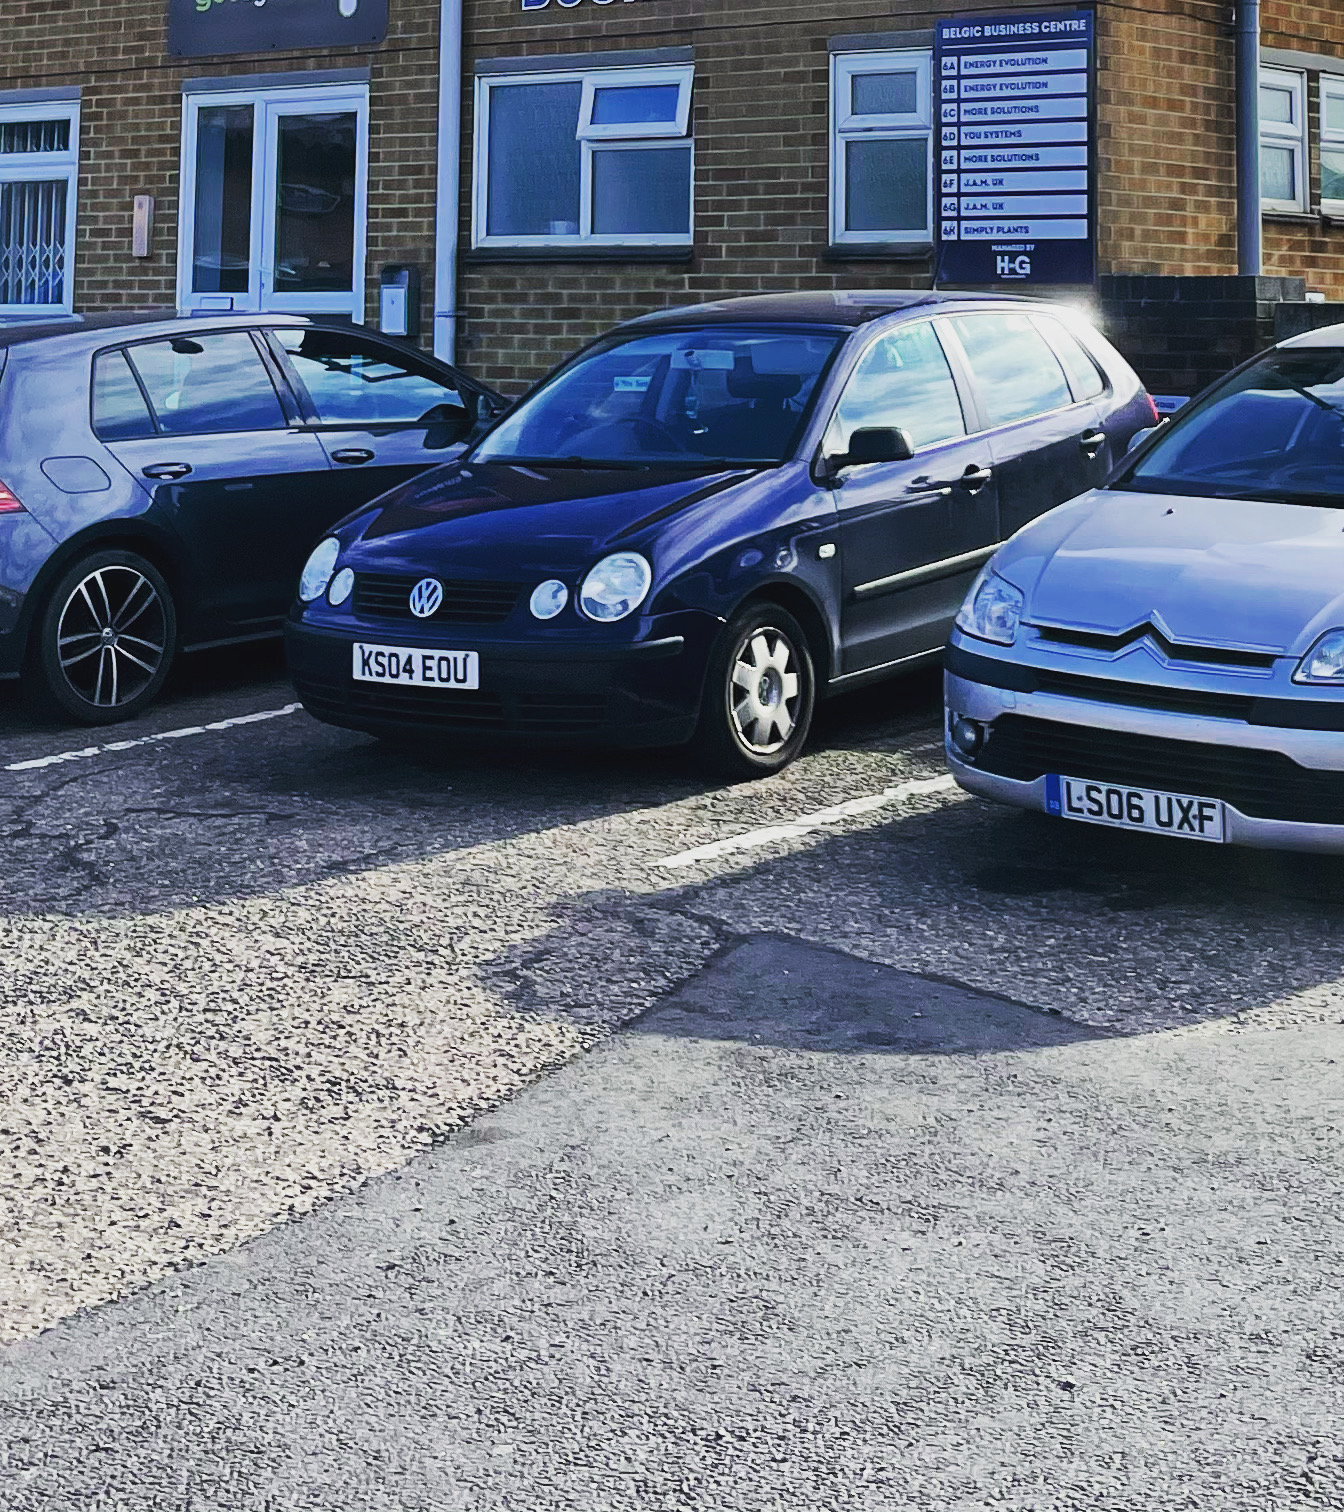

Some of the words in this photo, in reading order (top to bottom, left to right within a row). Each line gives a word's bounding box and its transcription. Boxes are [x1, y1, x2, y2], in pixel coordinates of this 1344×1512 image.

[942, 26, 982, 39] BELGIC
[984, 22, 1039, 37] BUSINESS
[1041, 19, 1086, 33] CENTRE
[942, 61, 955, 71] 6A
[963, 59, 997, 69] ENERGY
[999, 57, 1048, 67] EVOLUTION
[942, 84, 955, 94] 6B
[963, 83, 997, 93] ENERGY
[999, 81, 1048, 91] EVOLUTION
[942, 107, 955, 117] 6C
[963, 107, 988, 116] MORE
[990, 104, 1039, 115] SOLUTIONS
[942, 131, 955, 141] 6D
[963, 131, 982, 140] YOU
[983, 129, 1022, 139] SYSTEMS
[942, 155, 954, 165] 6E
[963, 154, 988, 163] MORE
[990, 152, 1040, 163] SOLUTIONS
[942, 179, 954, 189] 6F
[996, 225, 1029, 234] PLANTS
[361, 649, 415, 680] KS04
[422, 655, 468, 684] EOU
[1066, 781, 1144, 823] LS06
[1154, 795, 1217, 834] UXF
